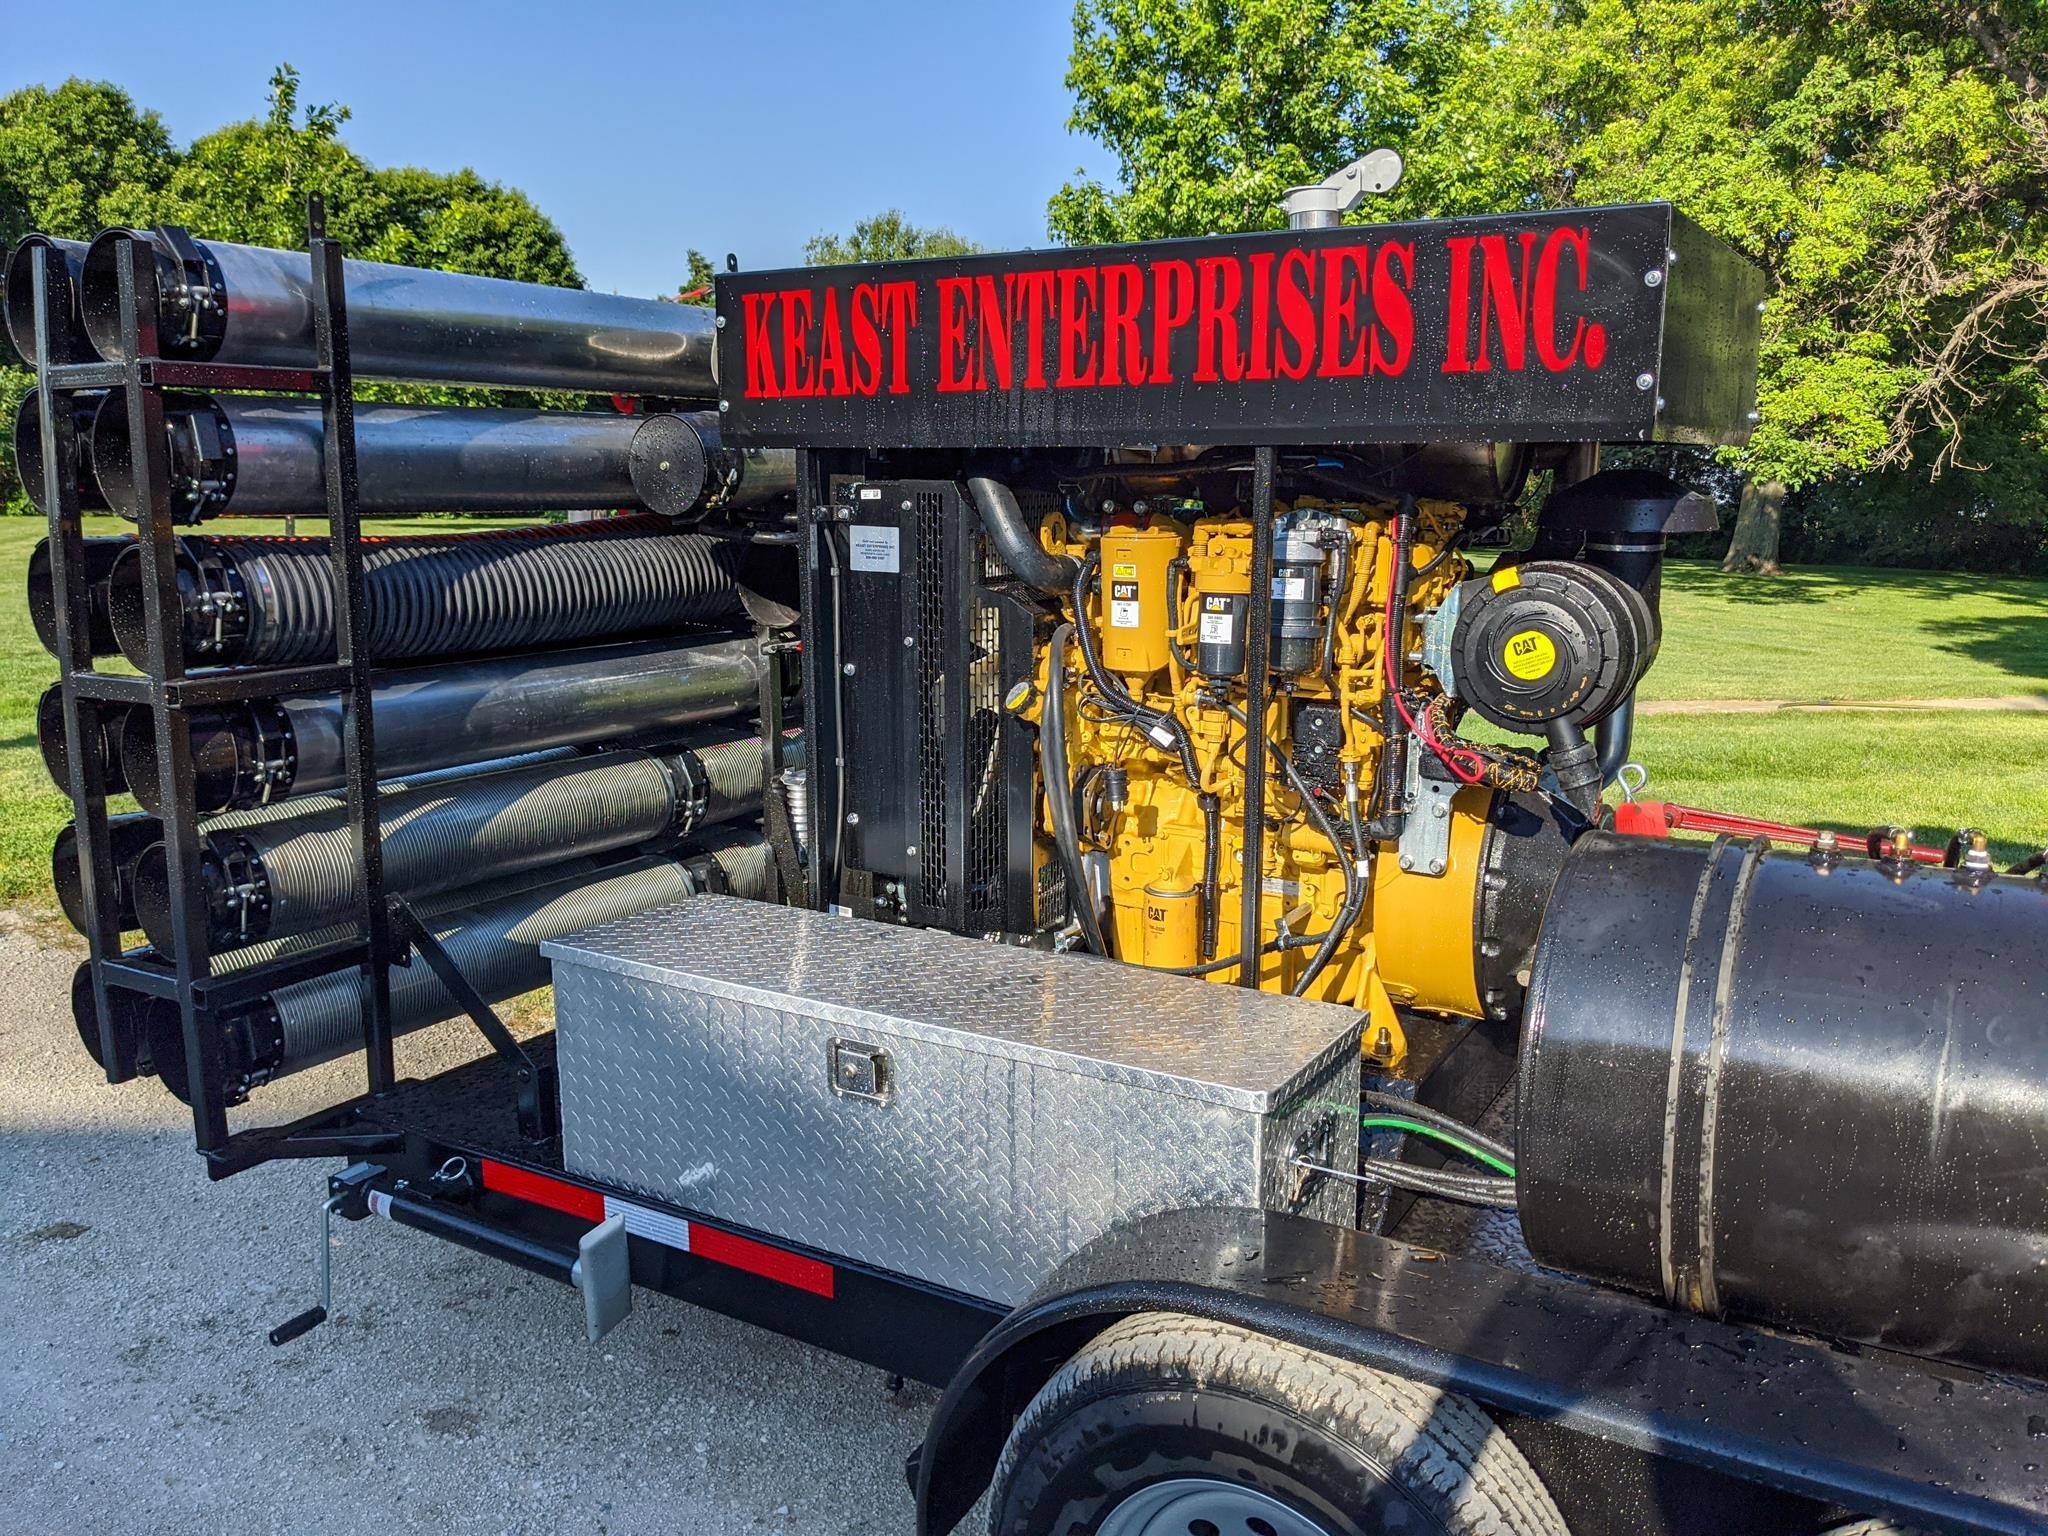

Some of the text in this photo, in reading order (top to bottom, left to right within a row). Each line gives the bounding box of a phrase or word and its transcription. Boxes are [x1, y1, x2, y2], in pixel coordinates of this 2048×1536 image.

[742, 226, 1606, 398] KEAST ENTERPRISES INC.
[1278, 568, 1291, 578] CAT
[1114, 584, 1133, 598] CAT
[1206, 596, 1226, 611] CAT
[1512, 636, 1537, 656] CAT
[1148, 906, 1167, 922] CAT
